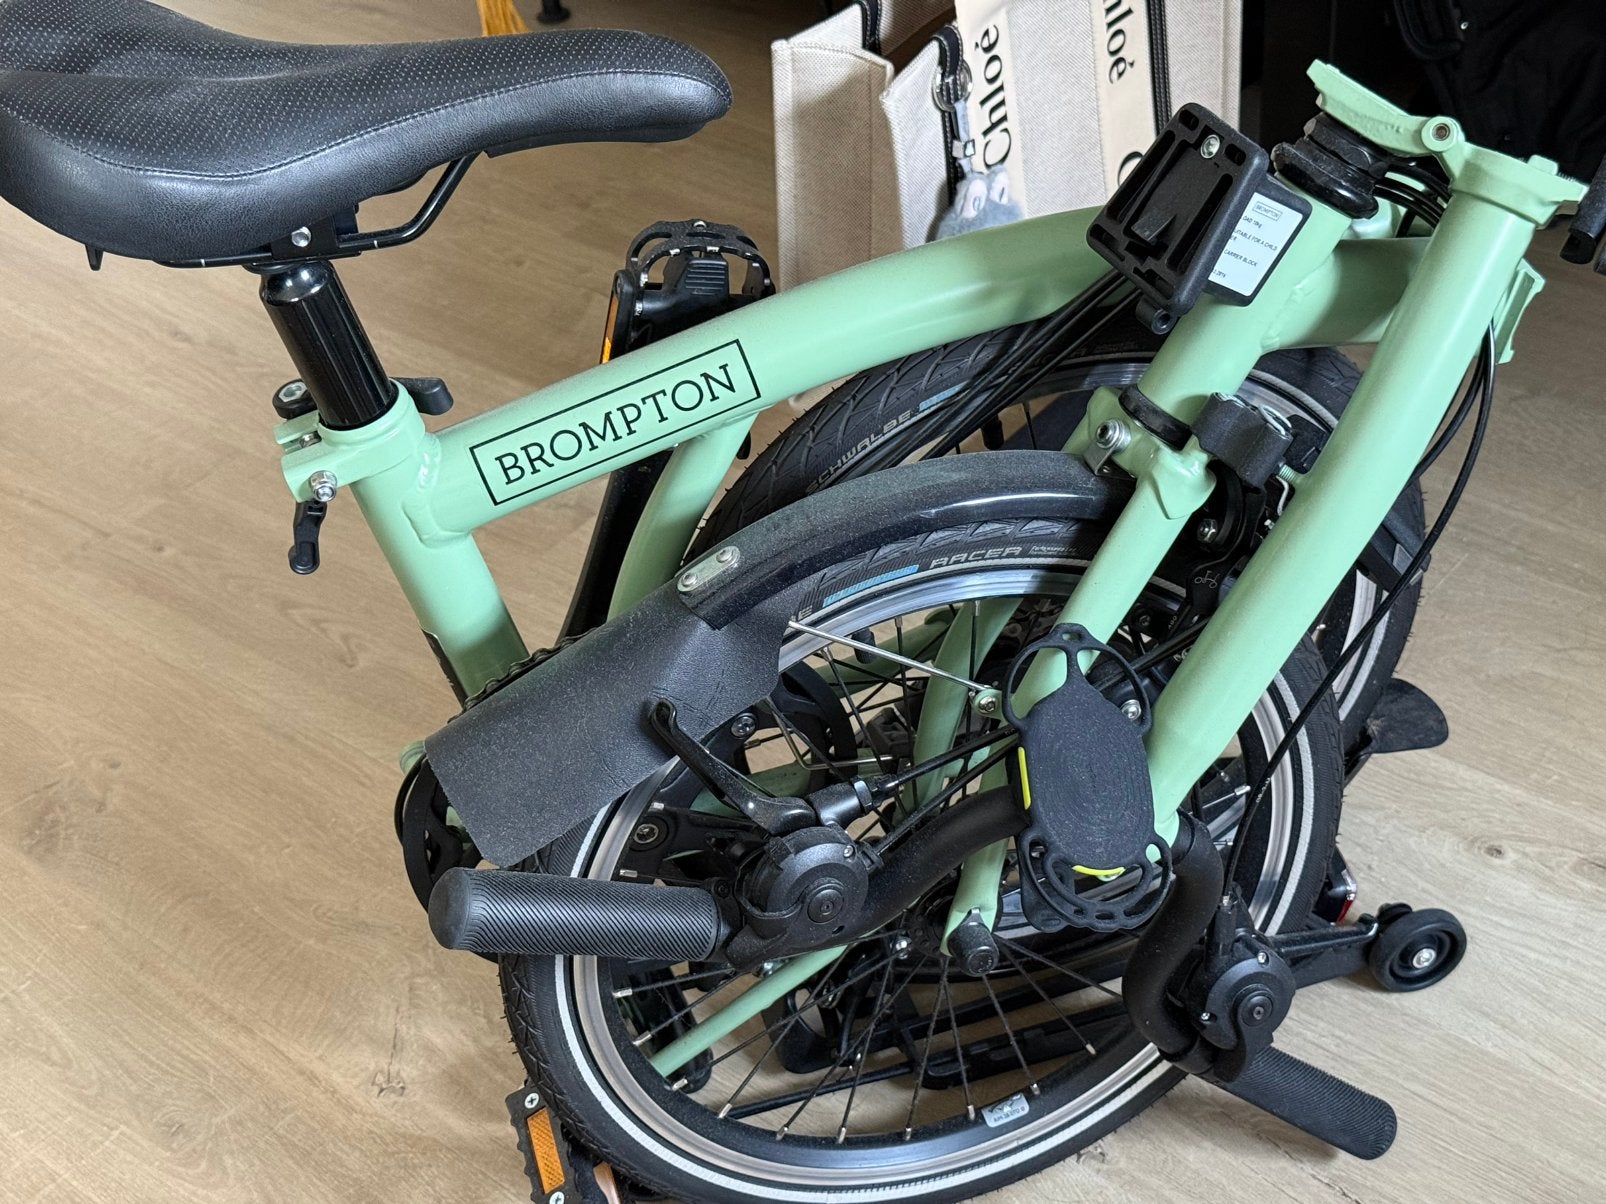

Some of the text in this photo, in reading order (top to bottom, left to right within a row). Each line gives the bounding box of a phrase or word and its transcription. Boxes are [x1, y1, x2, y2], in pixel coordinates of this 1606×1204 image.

[1104, 0, 1135, 84] loé
[974, 24, 1012, 170] Chloé
[1256, 204, 1280, 218] BROMPTON
[1242, 257, 1258, 267] BLOCK
[494, 363, 736, 486] BROMPTON
[805, 409, 912, 495] SCHWALBE
[929, 546, 1022, 569] RACER
